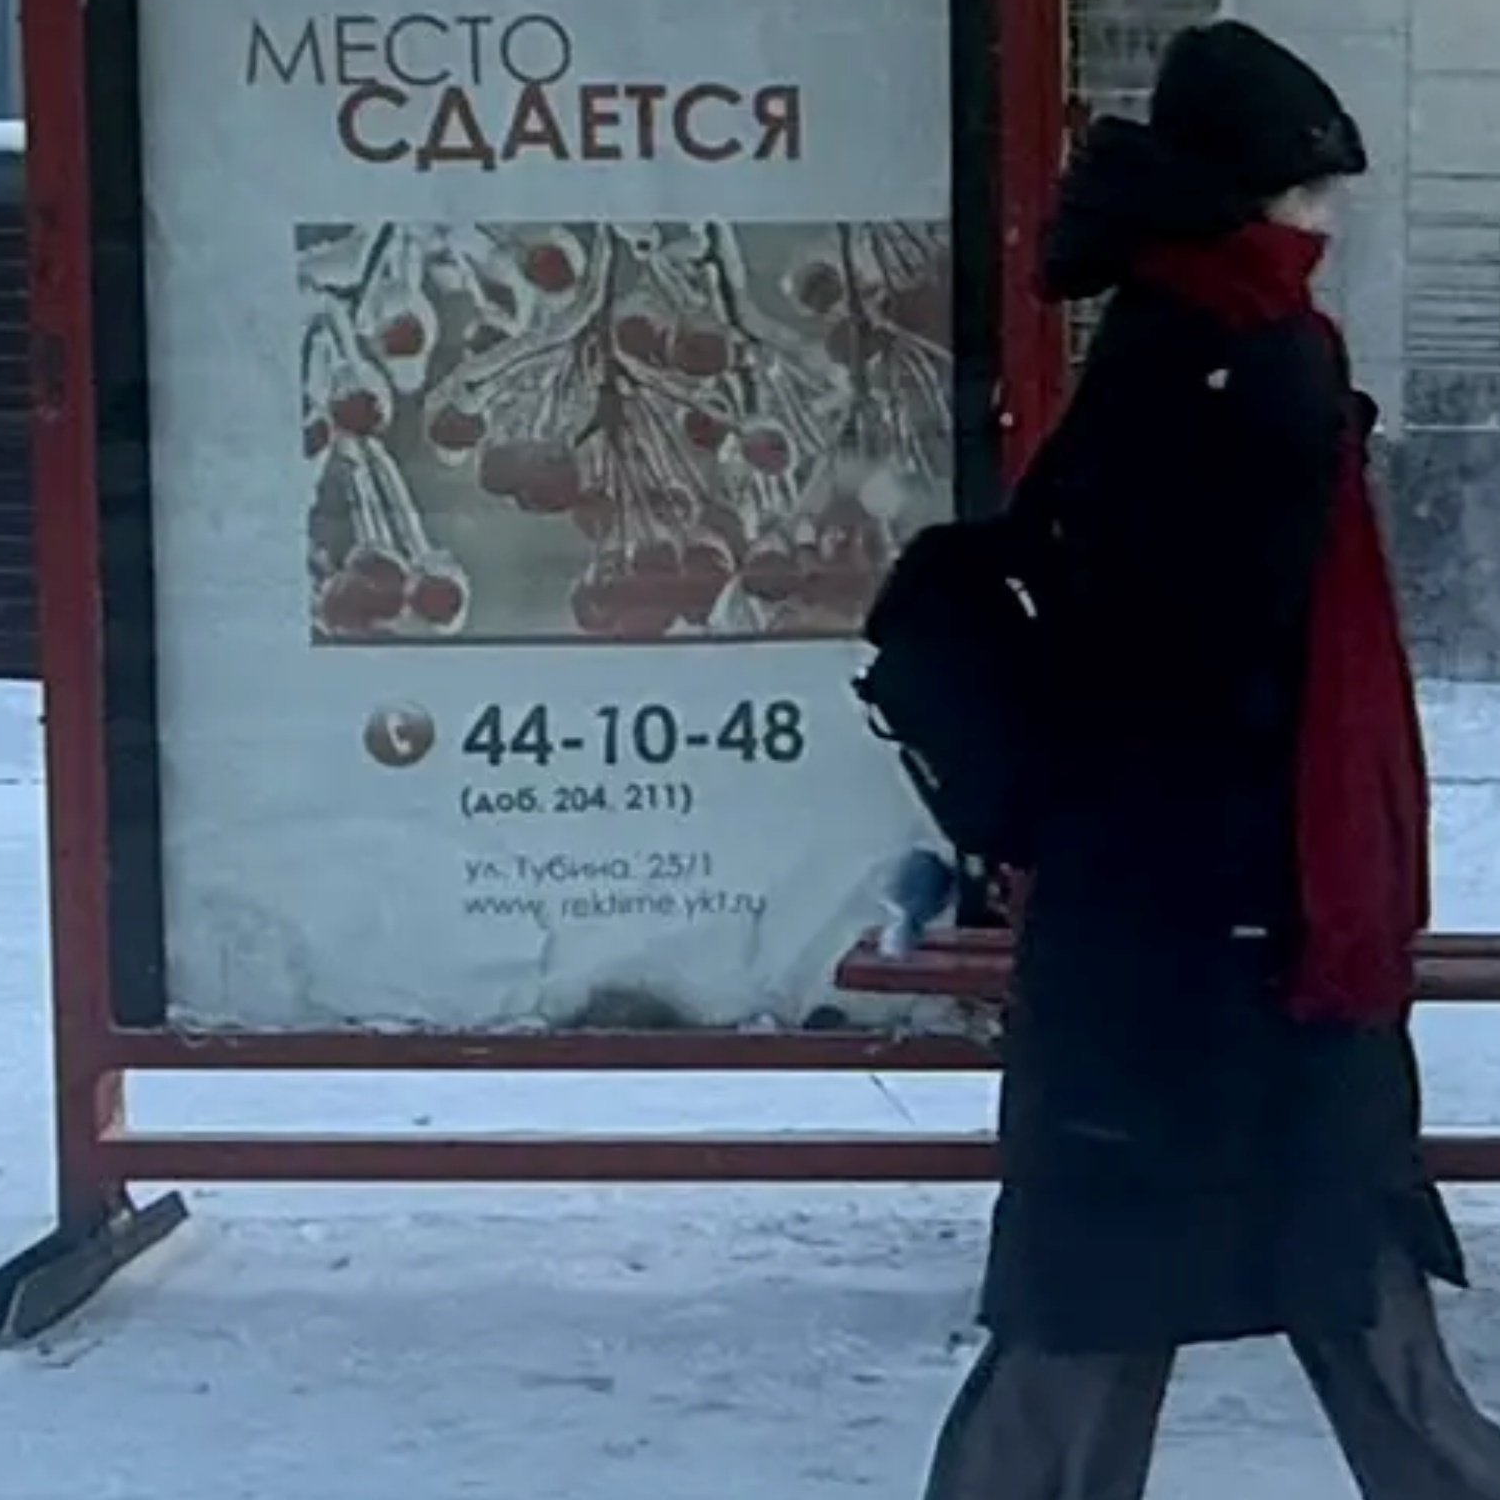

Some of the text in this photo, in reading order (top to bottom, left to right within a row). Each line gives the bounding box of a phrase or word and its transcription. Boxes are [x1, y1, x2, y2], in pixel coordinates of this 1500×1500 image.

[246, 15, 572, 86] МЕСТО
[337, 82, 801, 171] СДАЕТСЯ
[462, 700, 805, 766] 44-10-48
[624, 783, 692, 815] 211)
